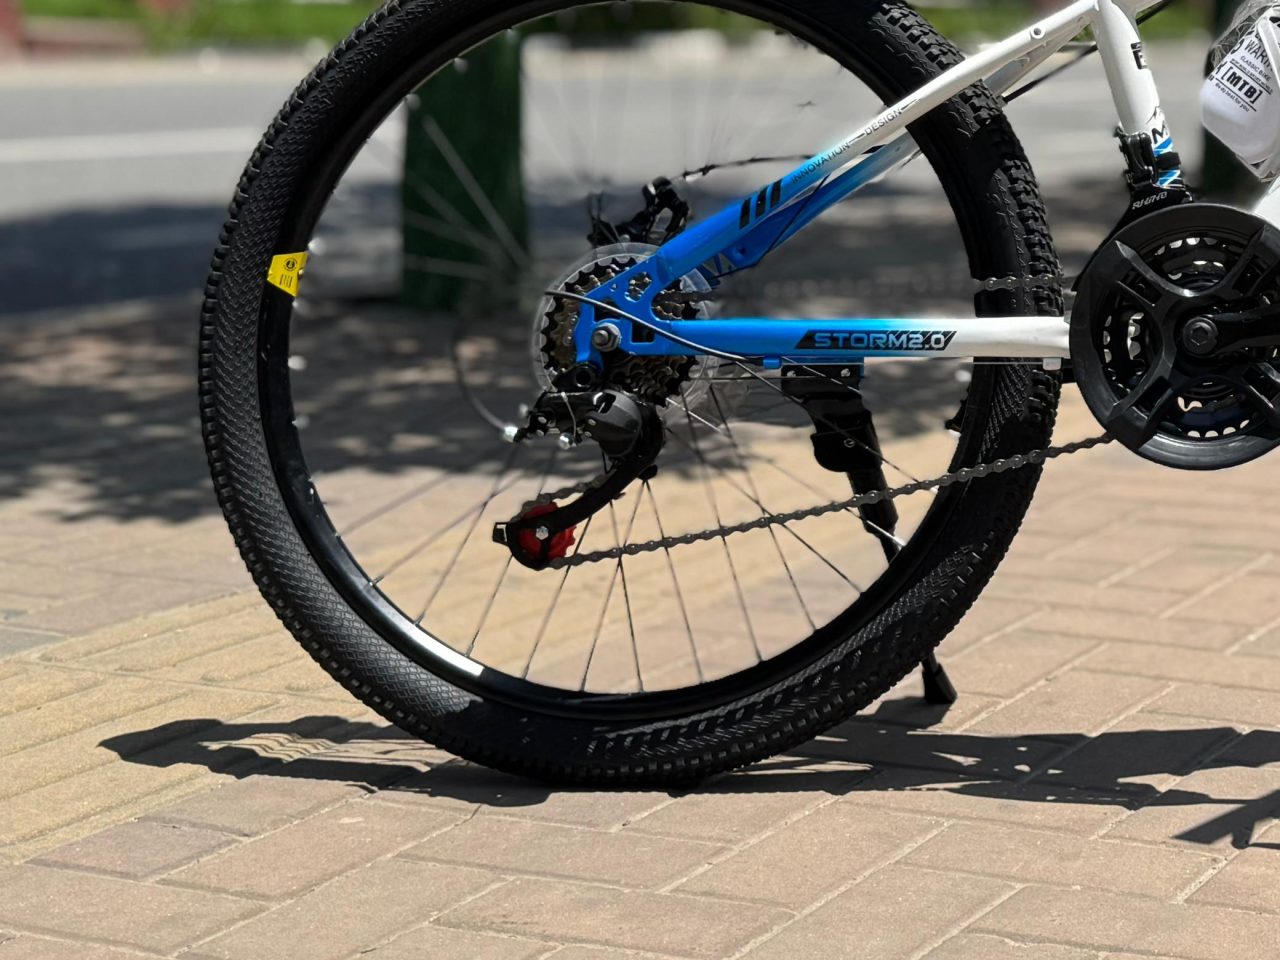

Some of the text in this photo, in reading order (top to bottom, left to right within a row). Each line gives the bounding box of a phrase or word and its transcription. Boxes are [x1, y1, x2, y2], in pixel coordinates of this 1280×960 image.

[1239, 54, 1259, 72] CLASSIC
[791, 108, 902, 183] INNOVATION DESIGN
[814, 332, 945, 349] STORM2.0
